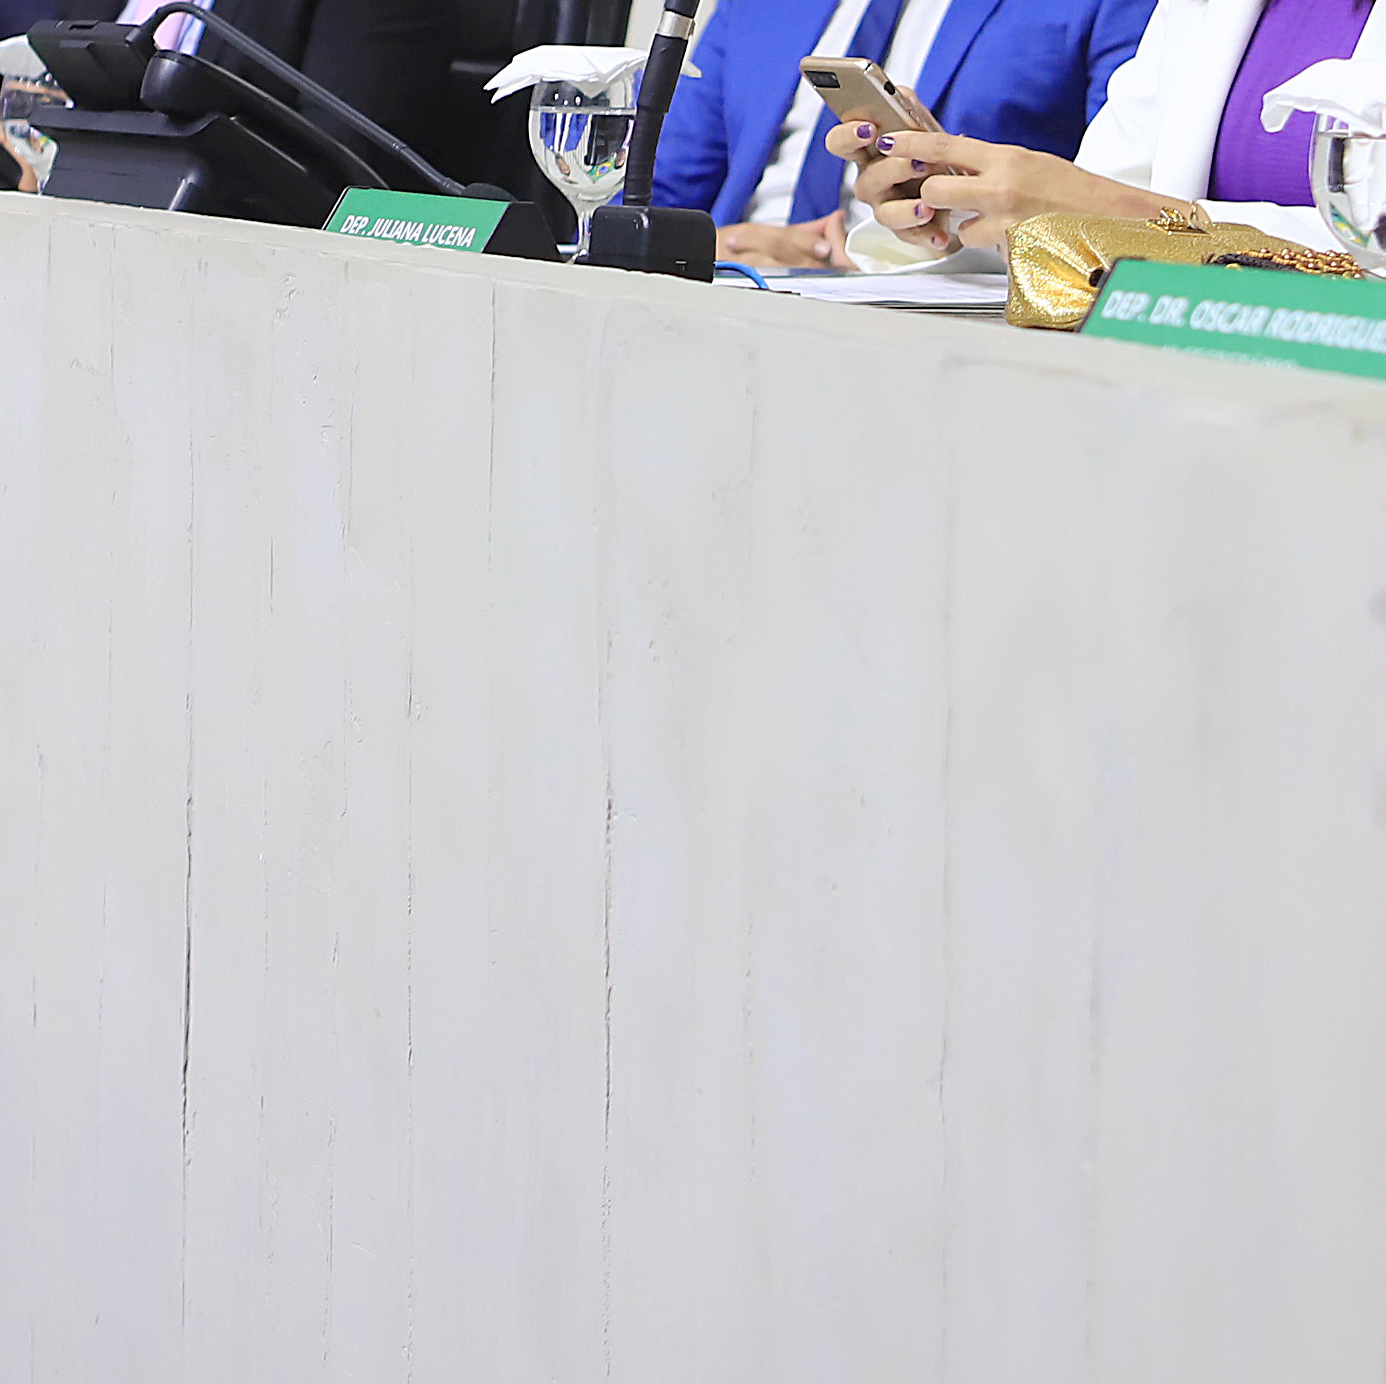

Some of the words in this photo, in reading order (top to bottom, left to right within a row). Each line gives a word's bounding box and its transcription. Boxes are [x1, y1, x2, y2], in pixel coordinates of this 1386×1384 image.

[340, 214, 370, 235] DEP.
[367, 218, 424, 243] JULIANA
[422, 223, 476, 248] LUCENA
[1101, 289, 1151, 322] DEP.
[1148, 295, 1190, 328] DR.
[1189, 298, 1272, 337] OSCAR
